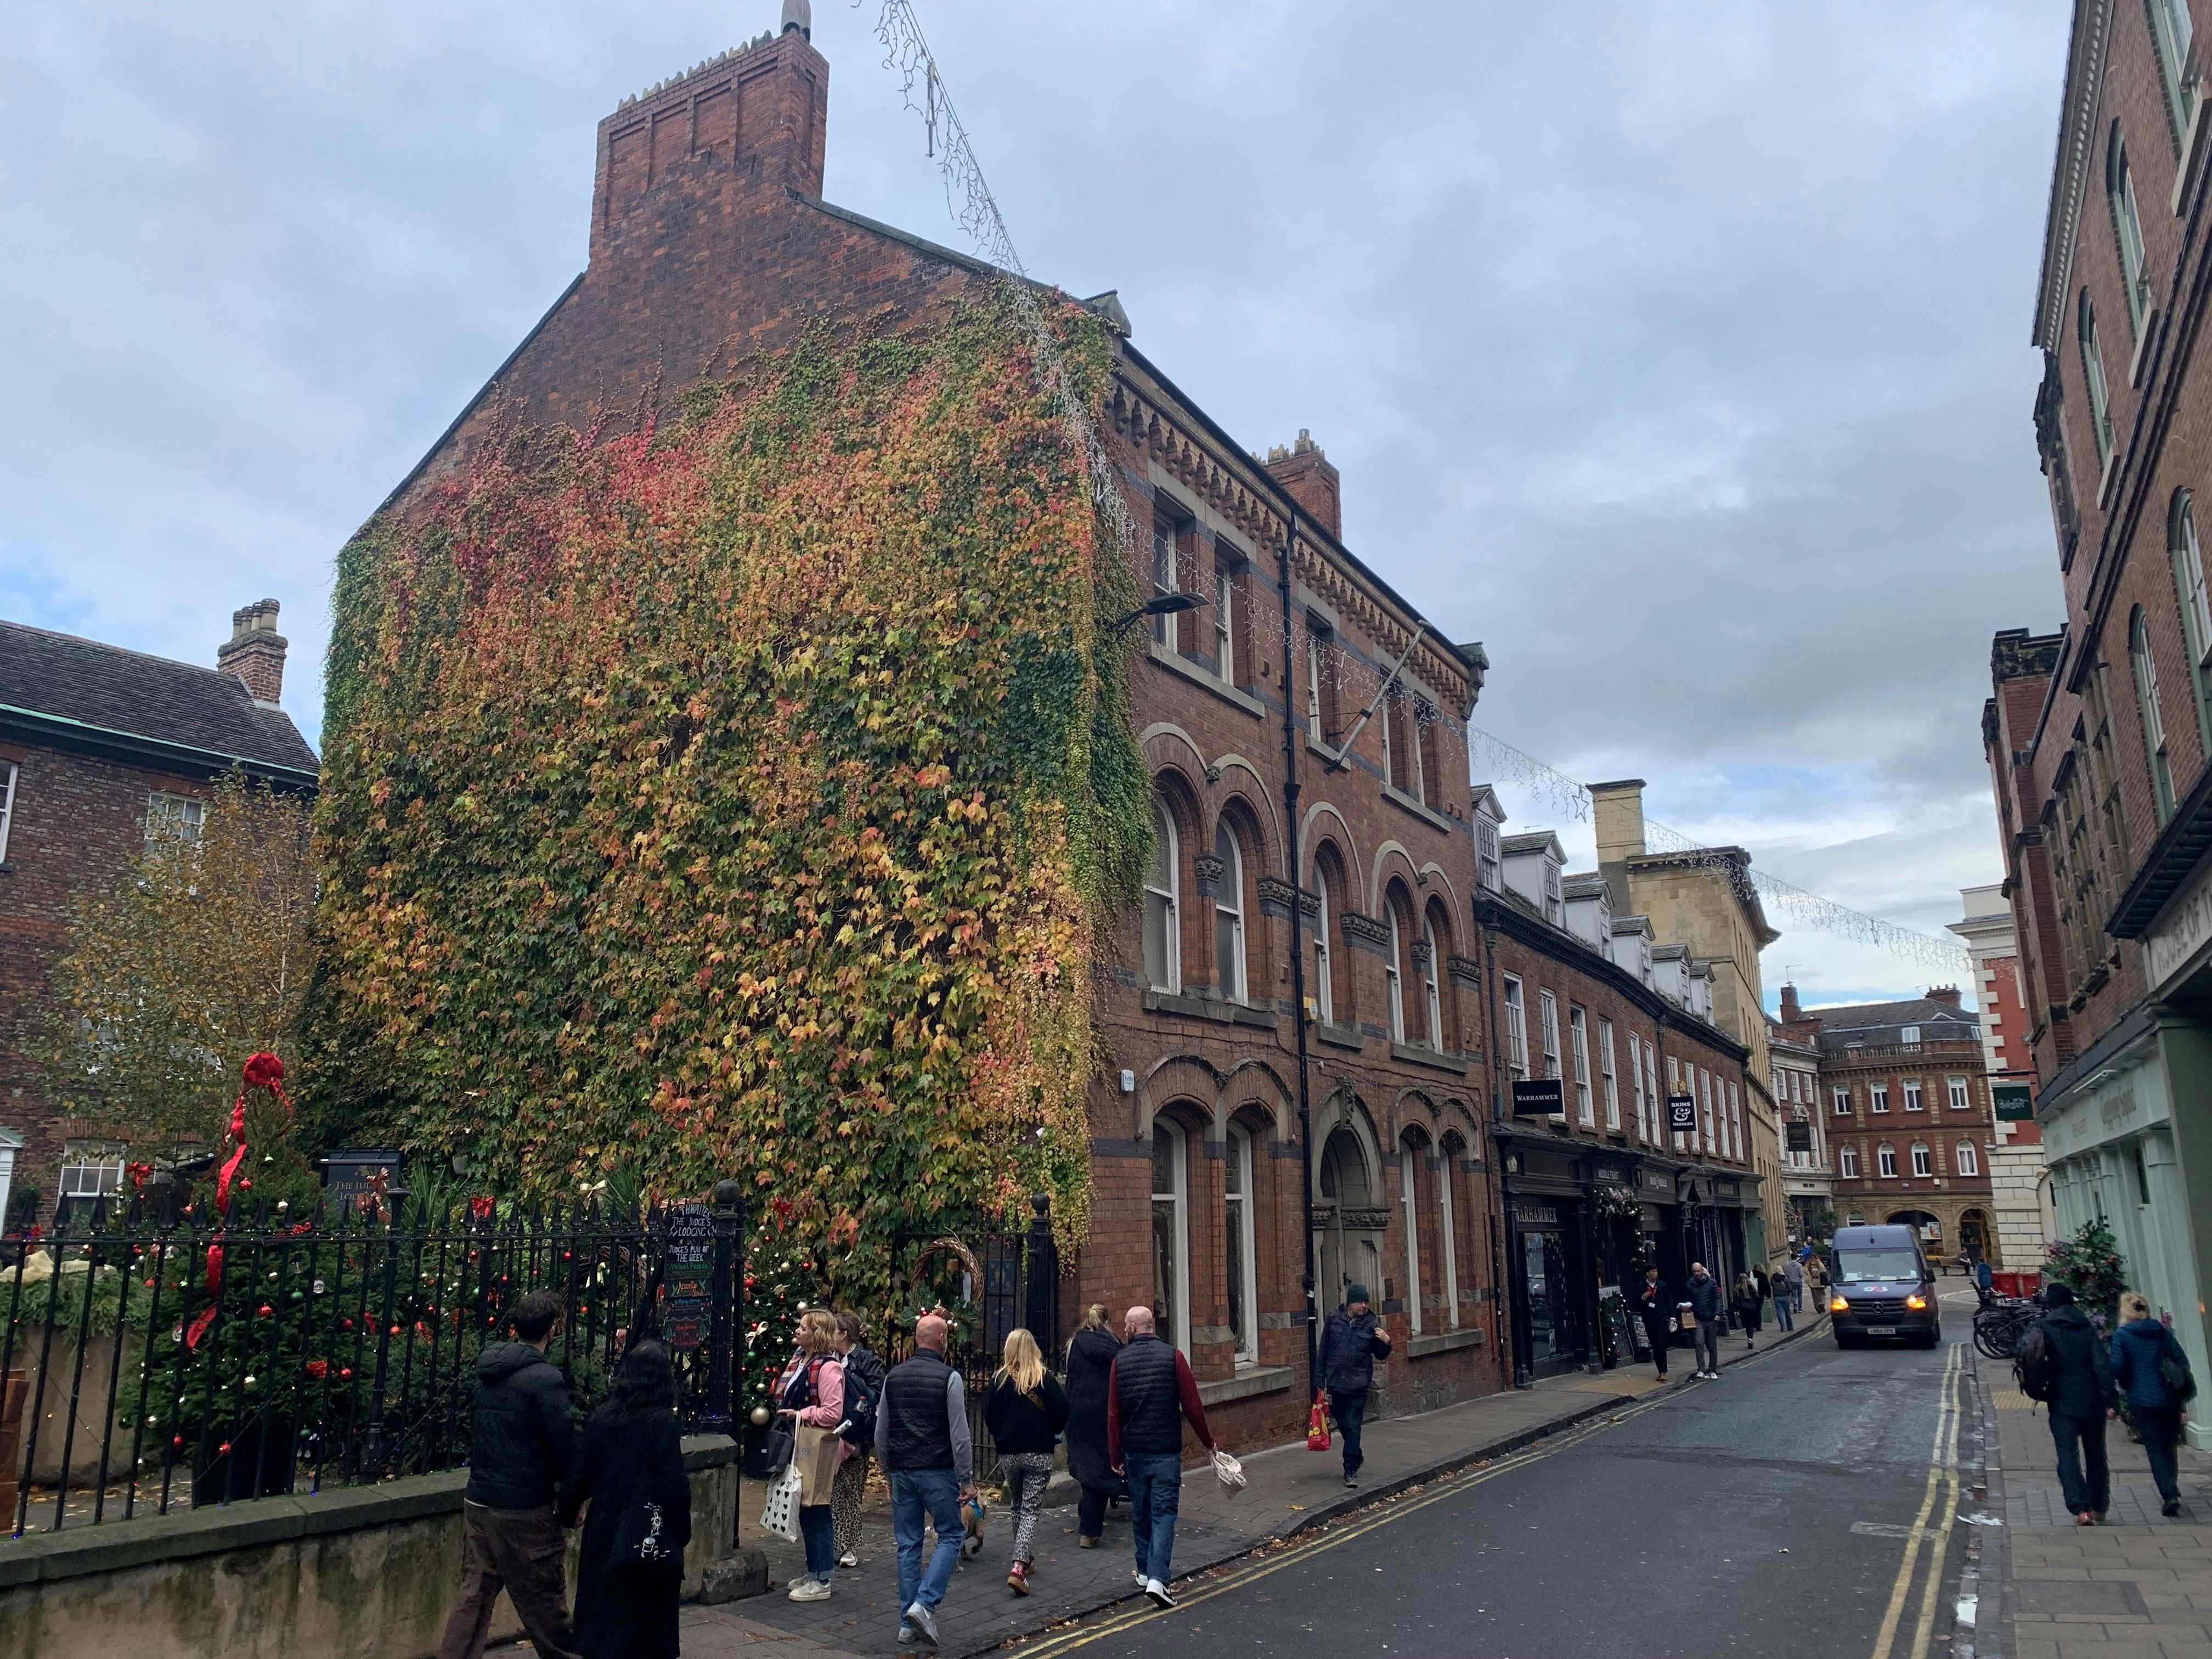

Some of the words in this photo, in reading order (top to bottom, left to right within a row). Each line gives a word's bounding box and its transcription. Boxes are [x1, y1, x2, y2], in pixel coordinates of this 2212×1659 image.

[2187, 896, 2200, 943] OF
[1674, 1108, 1691, 1121] &
[335, 1181, 353, 1190] THE
[680, 1203, 712, 1218] THWAITES
[672, 1217, 685, 1226] THE
[678, 1227, 707, 1237] LODGING
[676, 1253, 687, 1262] THE
[689, 1253, 703, 1262] WEEK
